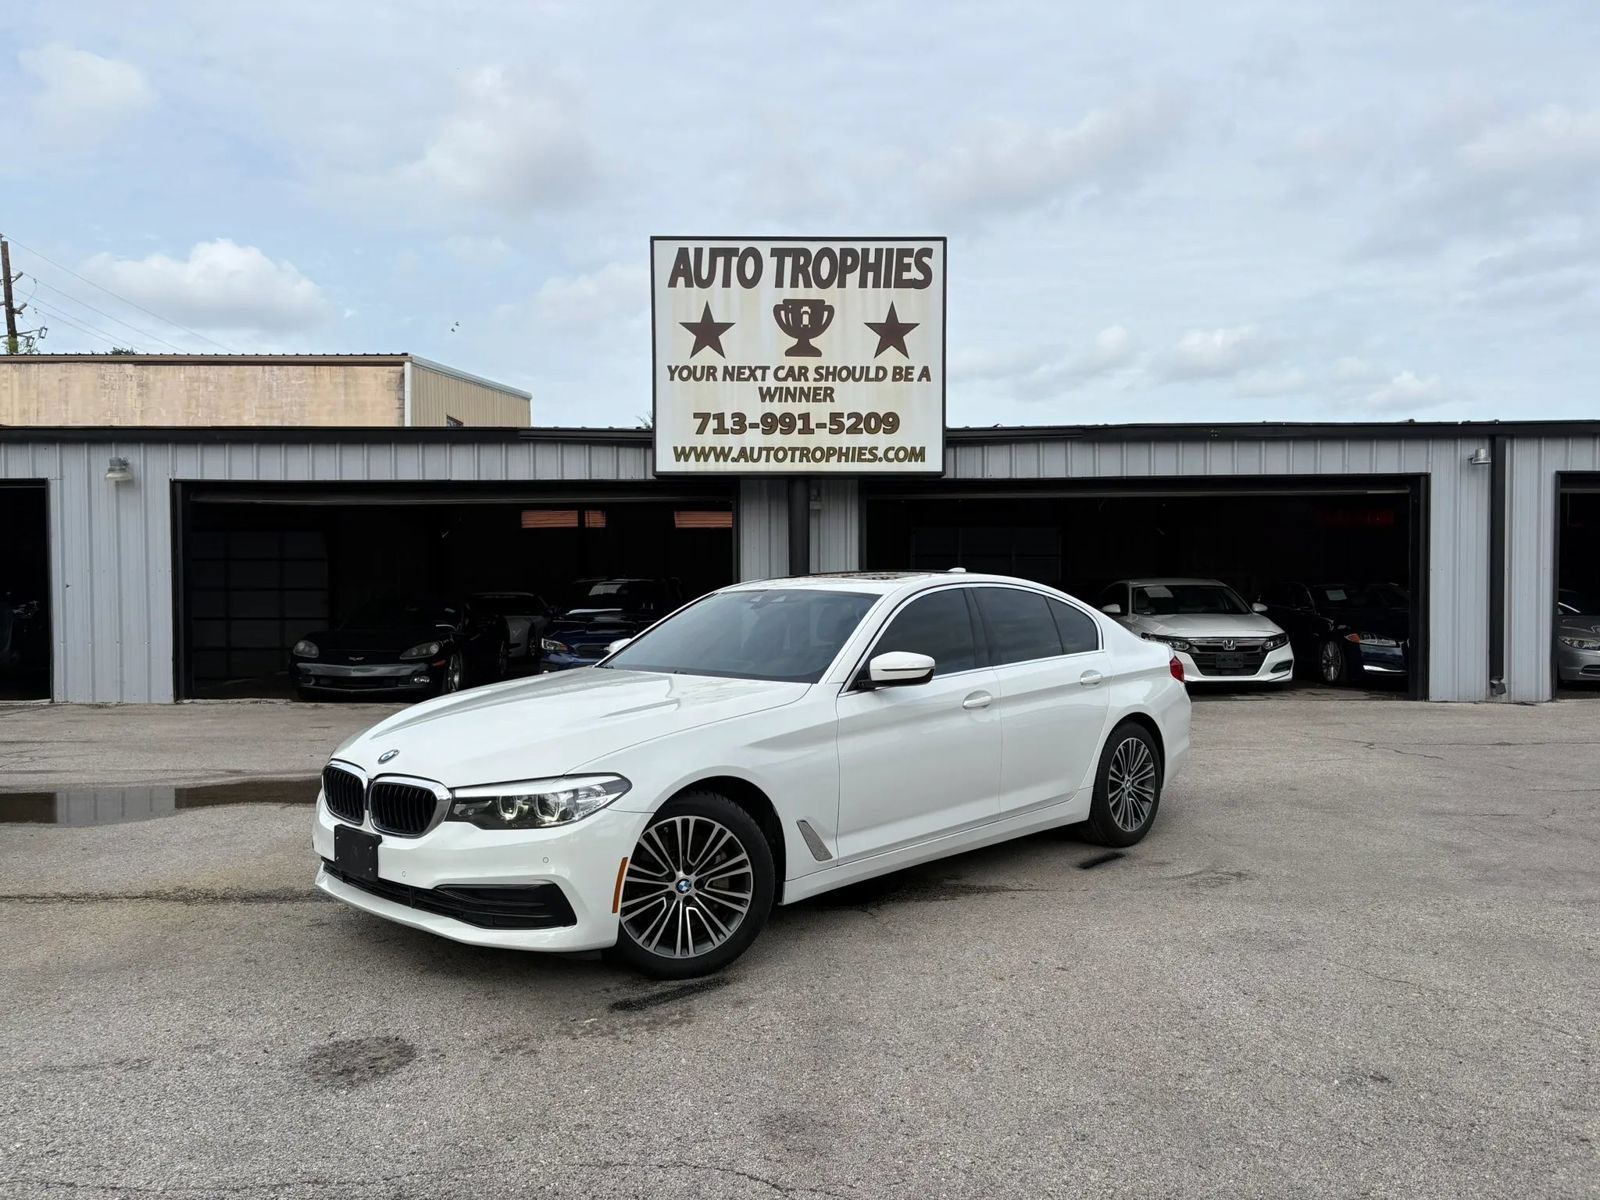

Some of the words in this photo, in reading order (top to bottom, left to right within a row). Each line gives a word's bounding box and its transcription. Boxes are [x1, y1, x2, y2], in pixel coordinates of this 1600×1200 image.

[667, 245, 764, 289] AUTO
[769, 246, 934, 290] TROPHIES
[667, 364, 718, 382] YOUR
[721, 364, 771, 382] NEXT
[773, 364, 810, 382] CAR
[813, 364, 888, 382] SHOULD
[891, 364, 914, 382] BE
[917, 365, 931, 382] A
[757, 386, 835, 403] WINNER
[692, 411, 900, 435] 713-991-5209
[672, 445, 926, 463] WWW.AUTOTROPHIES.COM
